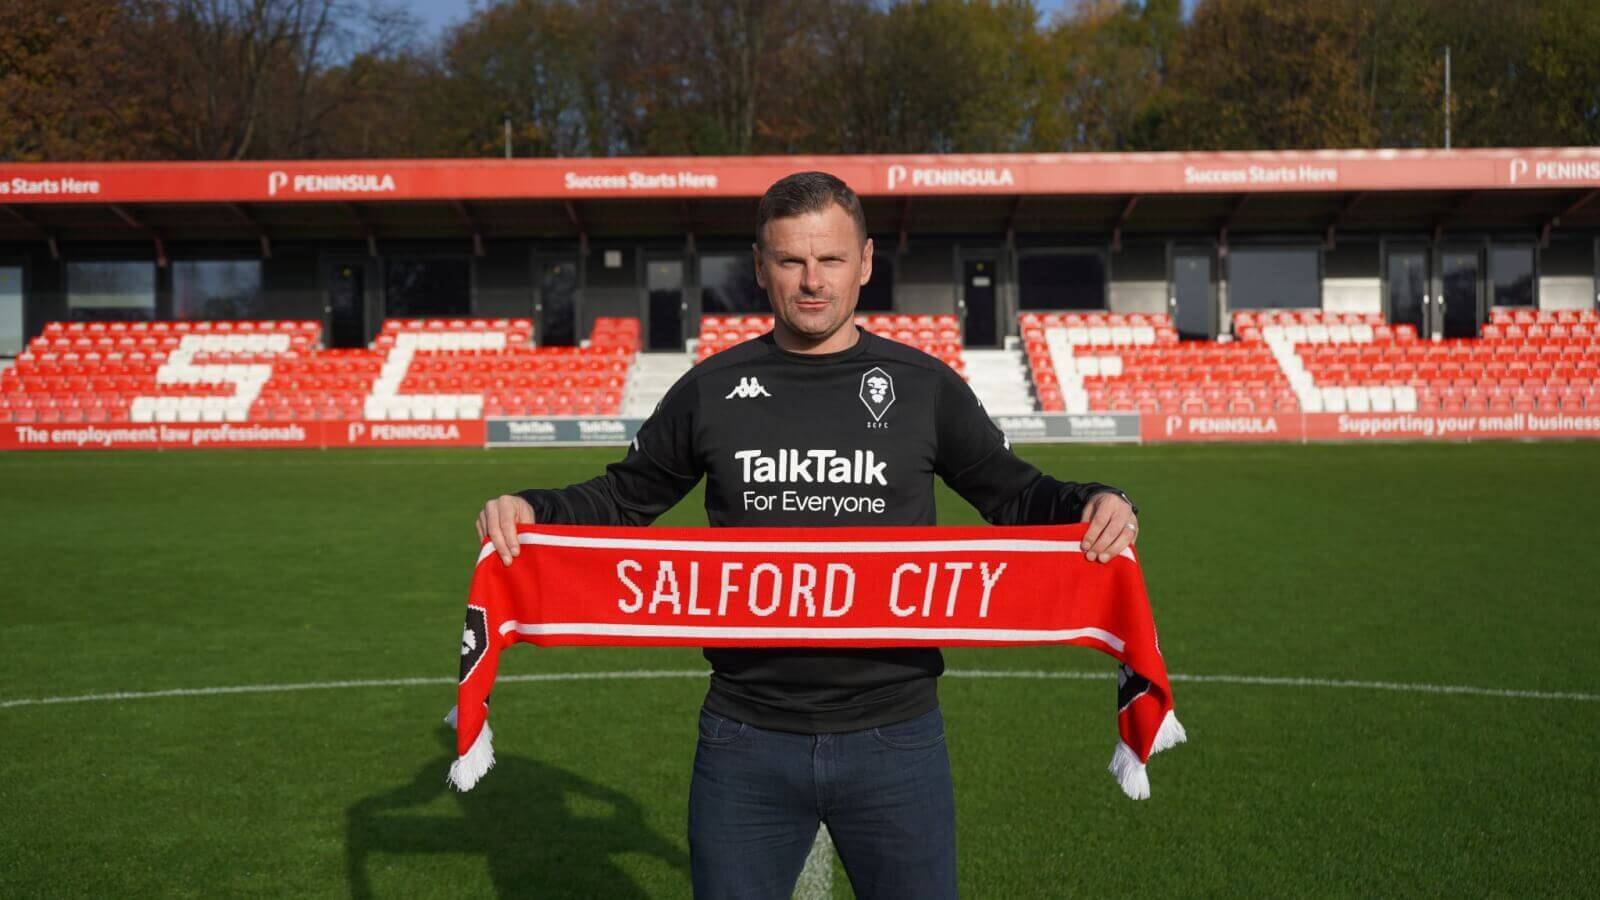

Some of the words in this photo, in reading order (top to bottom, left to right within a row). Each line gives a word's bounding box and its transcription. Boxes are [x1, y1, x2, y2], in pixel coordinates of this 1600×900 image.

[294, 174, 395, 192] PENINSULA
[565, 172, 627, 189] Success
[628, 172, 677, 189] Starts
[678, 171, 717, 188] Here
[912, 168, 1014, 187] PENINSULA
[1184, 166, 1247, 184] Success
[1248, 165, 1298, 184] Starts
[1299, 165, 1337, 183] Here
[11, 178, 59, 194] Starts
[61, 178, 100, 193] Here
[1189, 417, 1278, 434] PENINSULA
[1338, 414, 1434, 434] Supporting
[1436, 415, 1477, 434] your
[1478, 412, 1524, 431] small
[1527, 412, 1600, 431] business
[15, 425, 48, 443] The
[50, 426, 158, 446] employment
[159, 424, 189, 441] law
[191, 423, 306, 445] professionals
[371, 425, 460, 441] PENINSULA
[734, 448, 888, 486] TalkTalk
[743, 491, 777, 511] For
[782, 490, 886, 517] Everyone
[615, 558, 857, 619] SALFORD
[888, 561, 1008, 619] CITY
